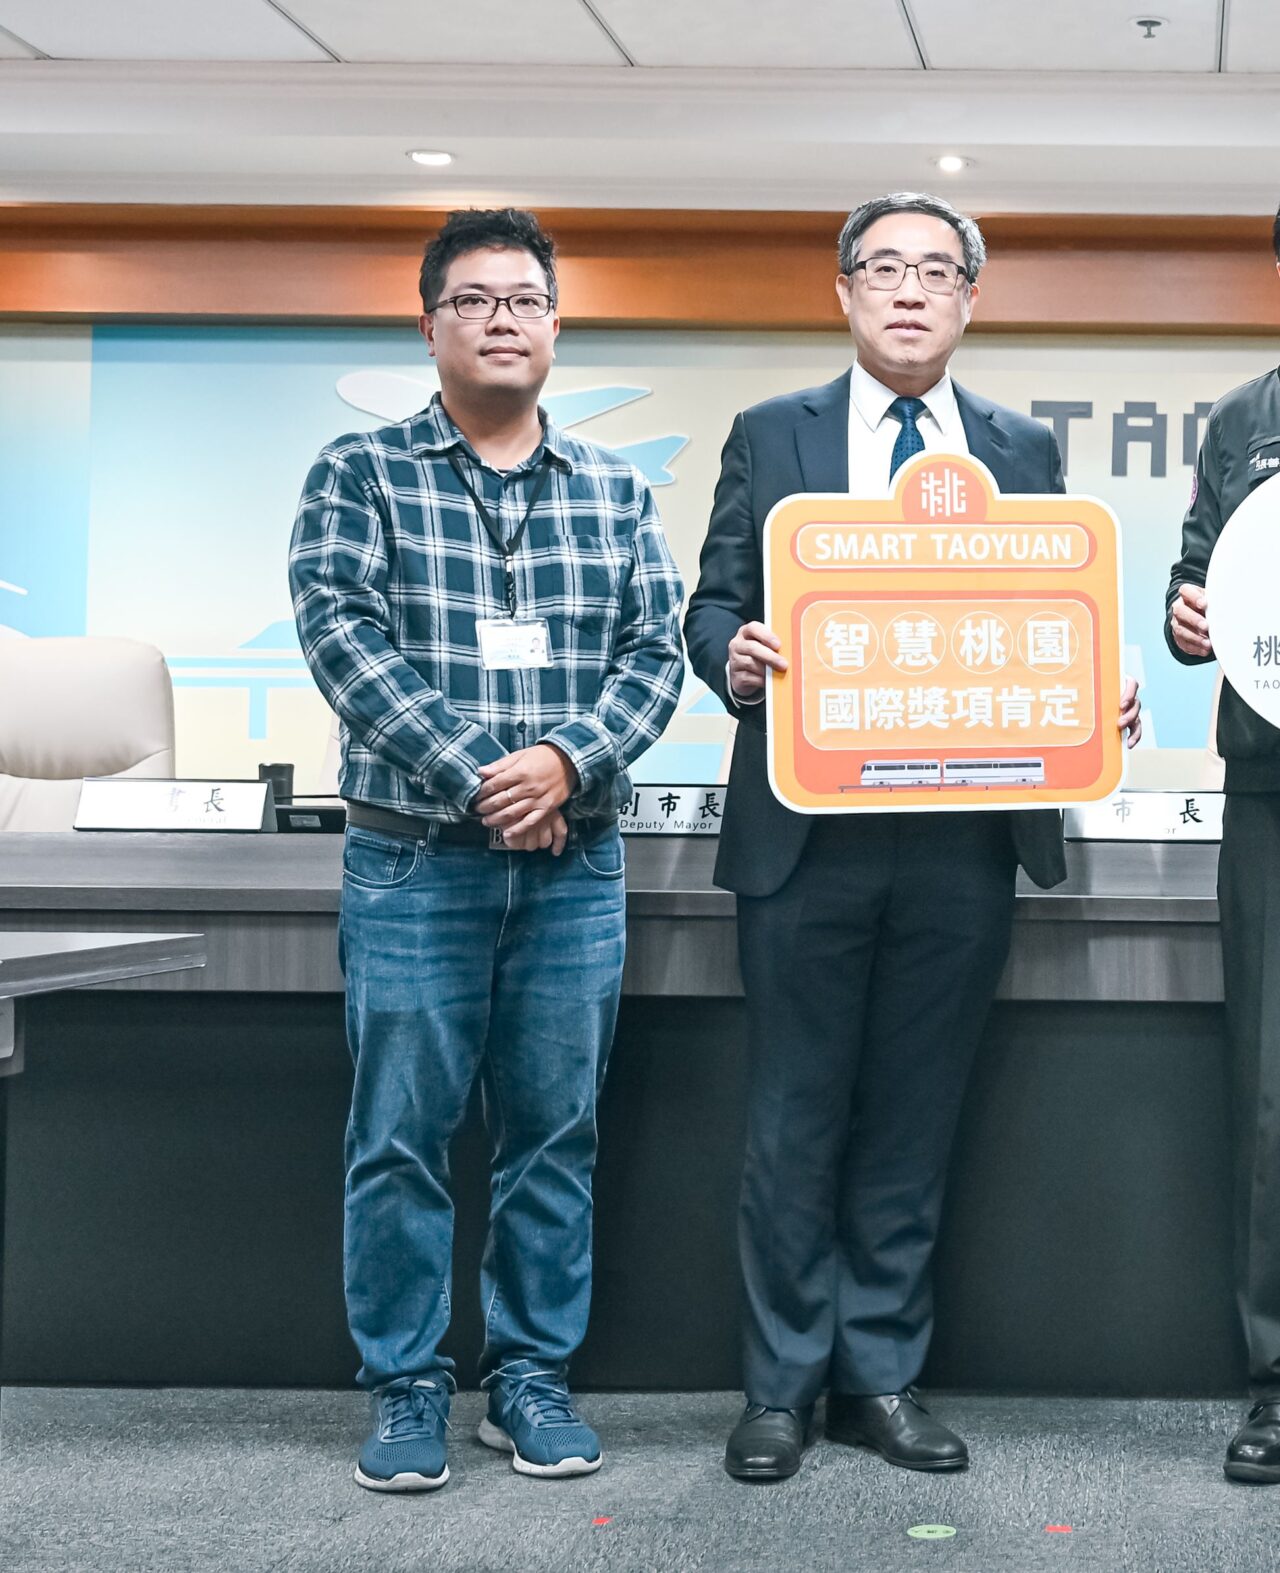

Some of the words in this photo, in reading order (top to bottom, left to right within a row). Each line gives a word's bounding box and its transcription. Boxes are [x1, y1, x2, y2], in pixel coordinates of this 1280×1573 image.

[815, 533, 917, 561] SMART
[931, 532, 1072, 560] TAOYUAN
[824, 619, 1071, 668] 智慧桃園
[819, 684, 1081, 732] 國際獎項肯定
[620, 819, 665, 831] Deputy
[674, 820, 713, 831] Mayor
